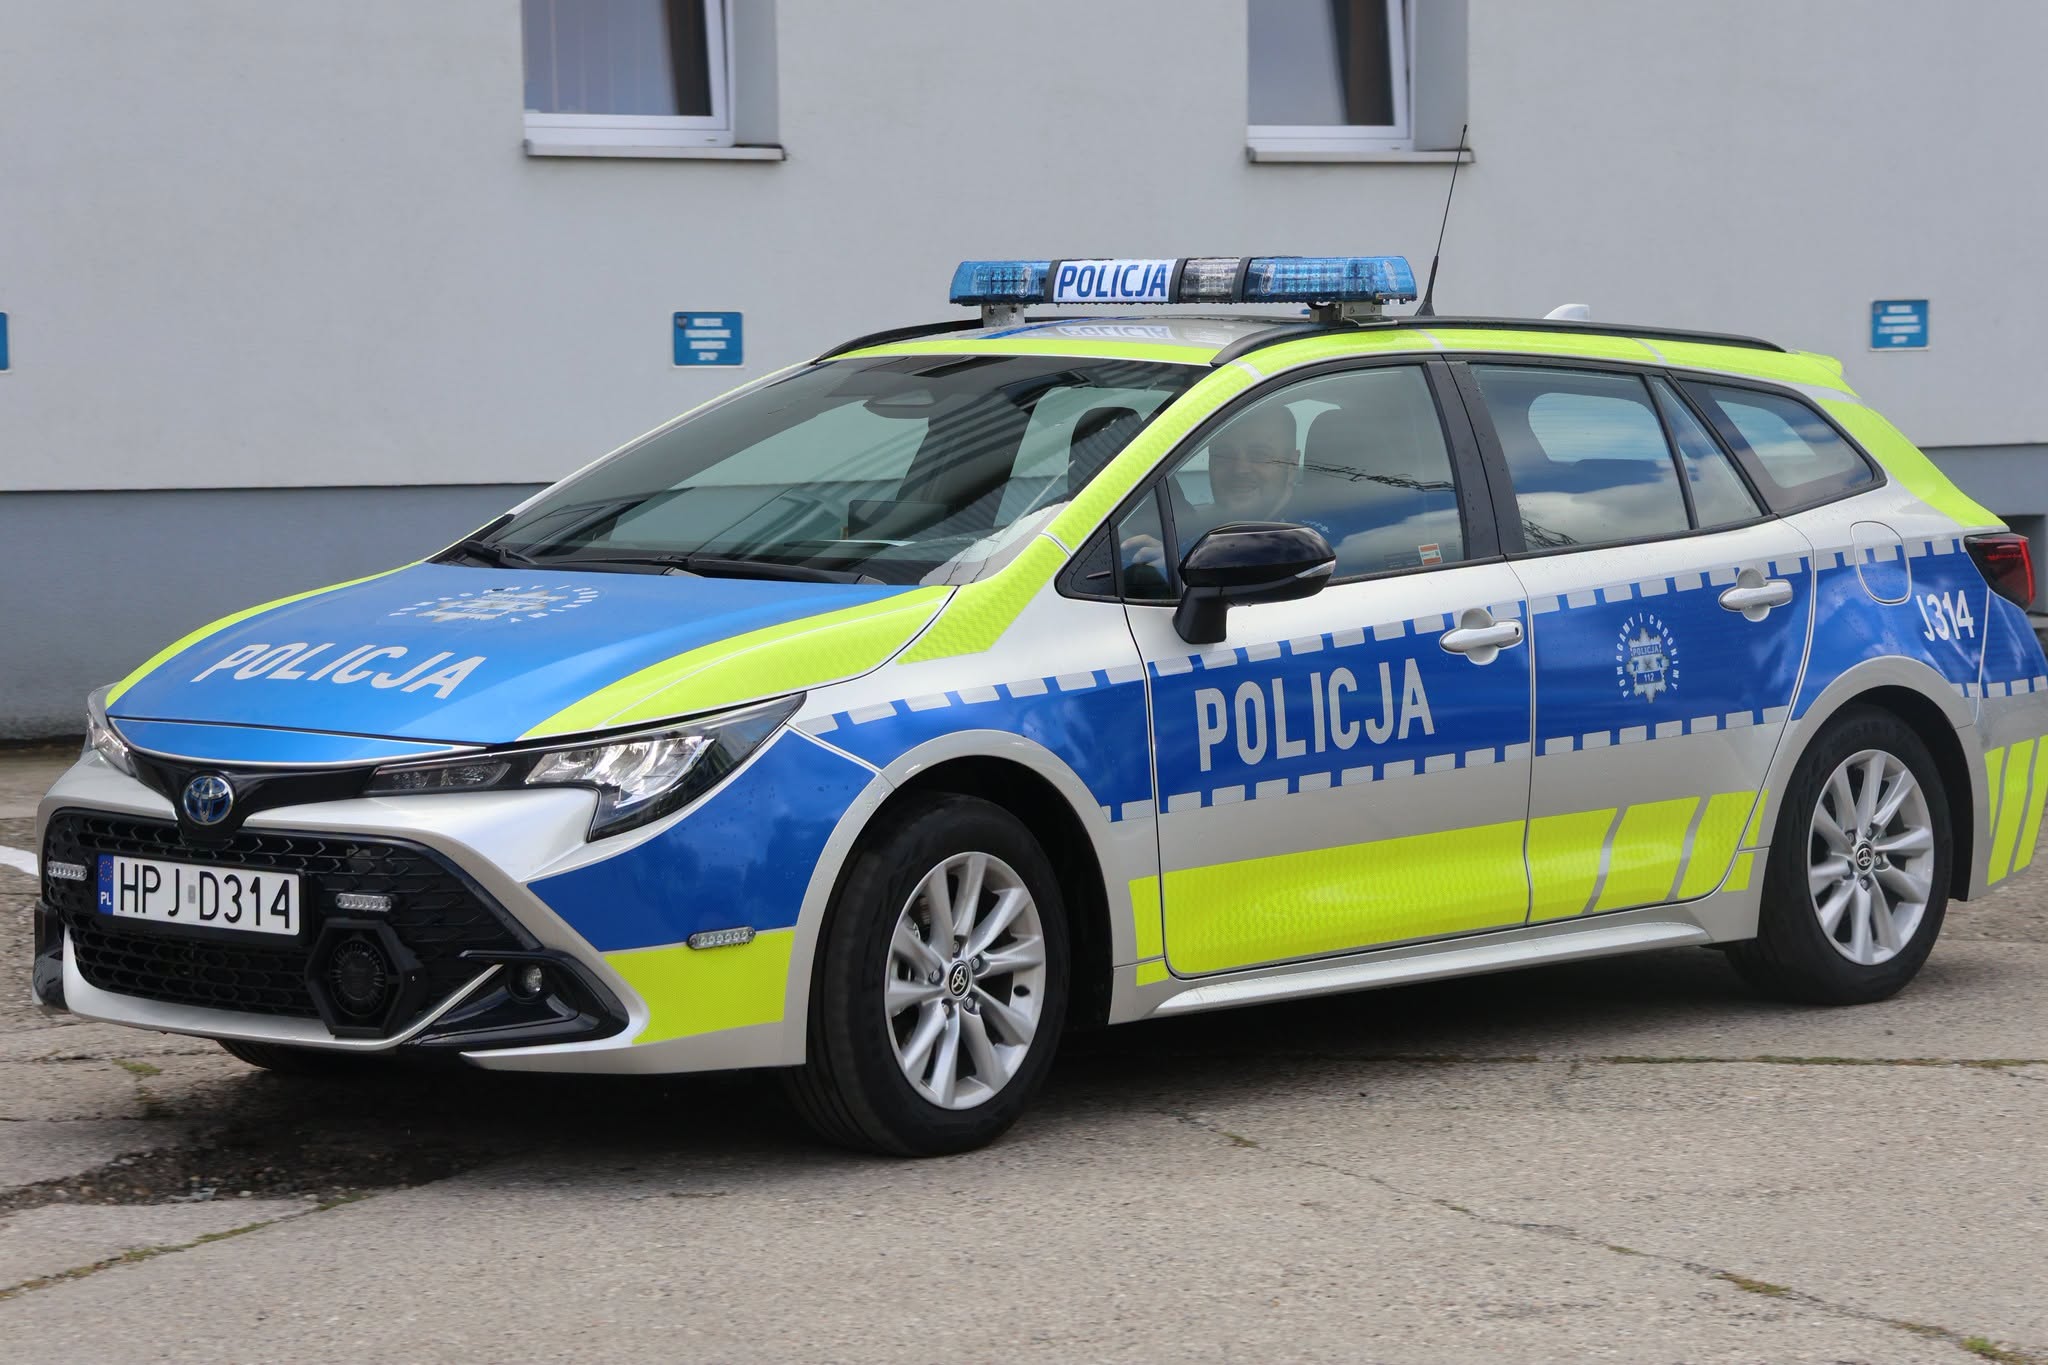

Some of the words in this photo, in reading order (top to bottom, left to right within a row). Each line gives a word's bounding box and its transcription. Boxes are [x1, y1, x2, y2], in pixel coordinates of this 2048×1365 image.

[1057, 264, 1167, 298] POLICJA
[1915, 589, 1975, 642] J314
[190, 641, 487, 700] POLICJA
[1632, 645, 1660, 656] POLICJA
[1643, 672, 1655, 682] 112
[1649, 614, 1680, 691] CHRONIMY
[1194, 657, 1435, 773] POLICJA
[100, 891, 112, 906] PL
[119, 861, 181, 918] HPJ
[199, 870, 290, 929] D314
